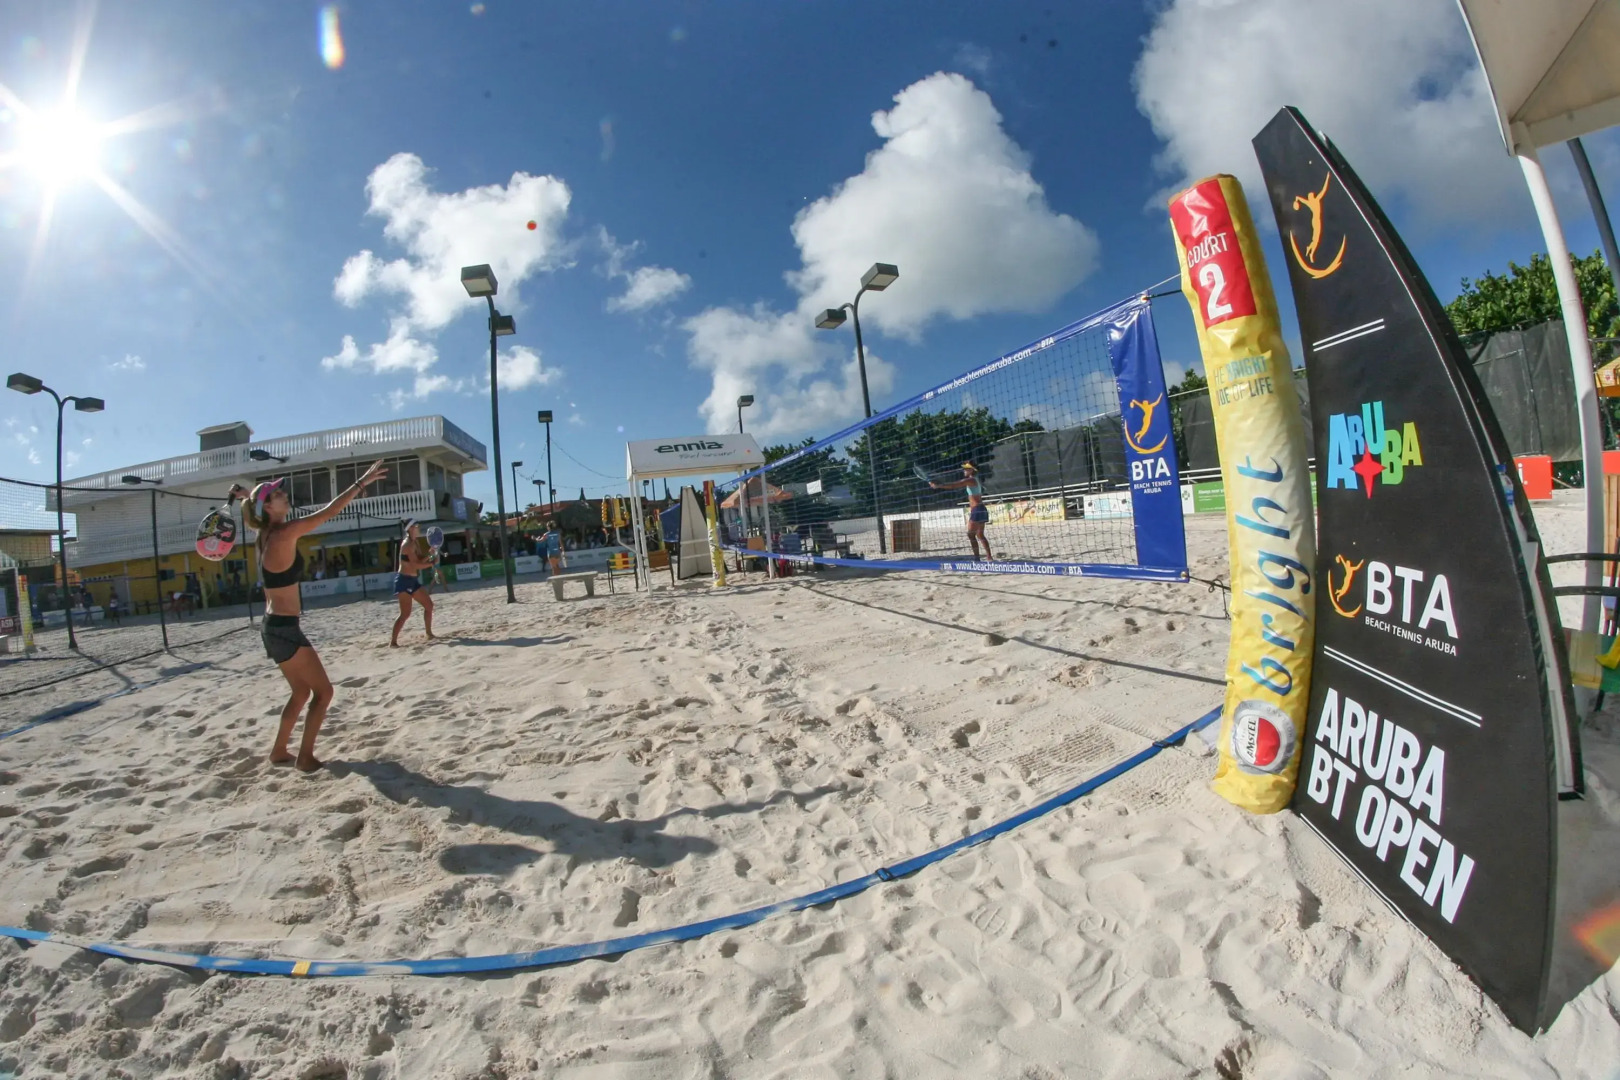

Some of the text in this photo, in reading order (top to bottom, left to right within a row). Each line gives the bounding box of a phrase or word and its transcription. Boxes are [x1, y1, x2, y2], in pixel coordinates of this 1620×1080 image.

[1187, 232, 1228, 268] COURT
[1199, 263, 1233, 320] 2
[1041, 336, 1054, 348] BTA
[1213, 356, 1267, 385] HE BRIGHT
[1216, 376, 1273, 406] IDE OF LIFE
[654, 440, 724, 454] ennia
[1326, 401, 1423, 489] ARUBA
[1131, 457, 1171, 481] BTA
[1134, 479, 1172, 490] BEACH TENNIS
[955, 561, 1056, 574] www.beachtennisaruba.com
[1068, 565, 1083, 576] BTA
[1236, 454, 1311, 696] bright
[1366, 561, 1459, 639] BTA
[1365, 616, 1457, 657] BEACH TENNIS ARUBA
[1246, 720, 1256, 758] AMSTEL
[1315, 687, 1445, 826] ARUBA
[1307, 743, 1475, 924] BT OPEN
